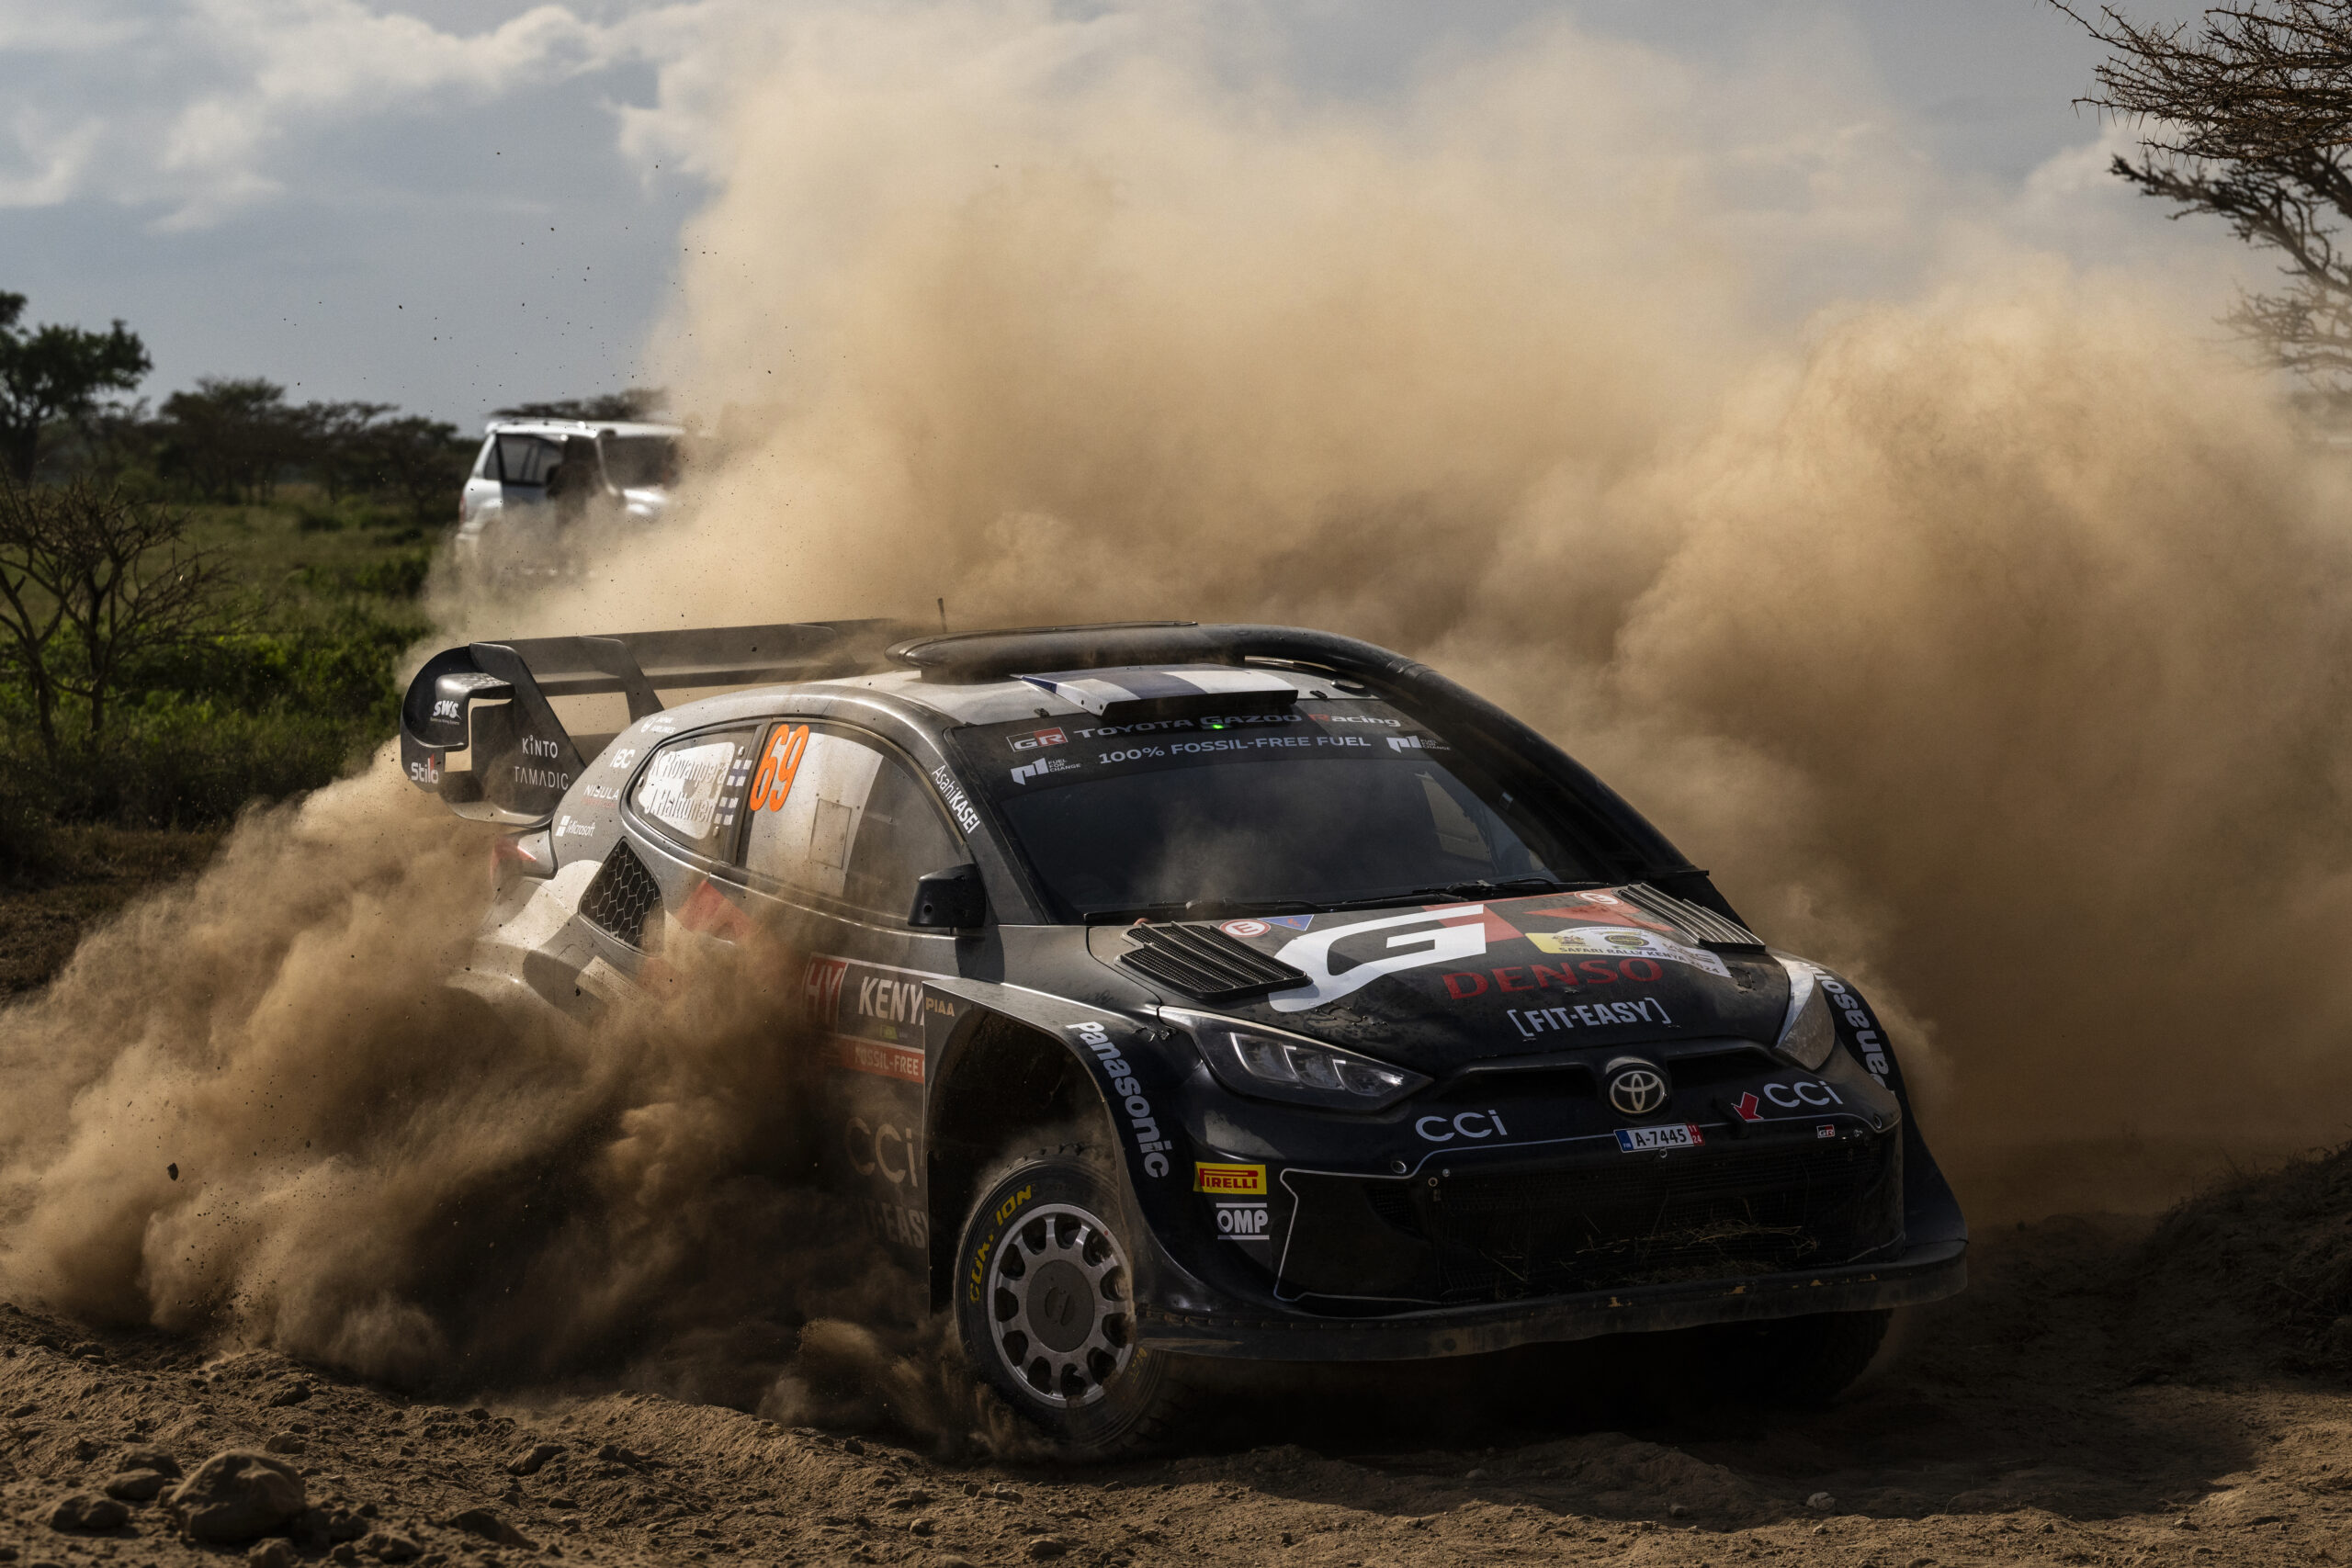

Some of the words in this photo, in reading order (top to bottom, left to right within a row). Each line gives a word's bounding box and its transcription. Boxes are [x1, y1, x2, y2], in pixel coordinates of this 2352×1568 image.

[433, 700, 459, 718] SWS
[1013, 733, 1068, 750] GR
[1099, 746, 1165, 764] 100%
[1170, 737, 1311, 755] FOSSIL-FREE
[1317, 736, 1372, 747] FUEL
[411, 754, 439, 784] Stilo
[514, 766, 569, 791] TAMADIC
[750, 724, 809, 812] 69
[583, 785, 619, 800] NISULA
[565, 819, 595, 837] Microsoft
[1442, 957, 1664, 1000] DENSO
[925, 997, 956, 1018] PIAA
[1066, 1021, 1172, 1179] Panasonic
[1635, 1128, 1688, 1147] A-7445
[1199, 1168, 1259, 1189] PIRELLI
[1217, 1210, 1268, 1234] OMP
